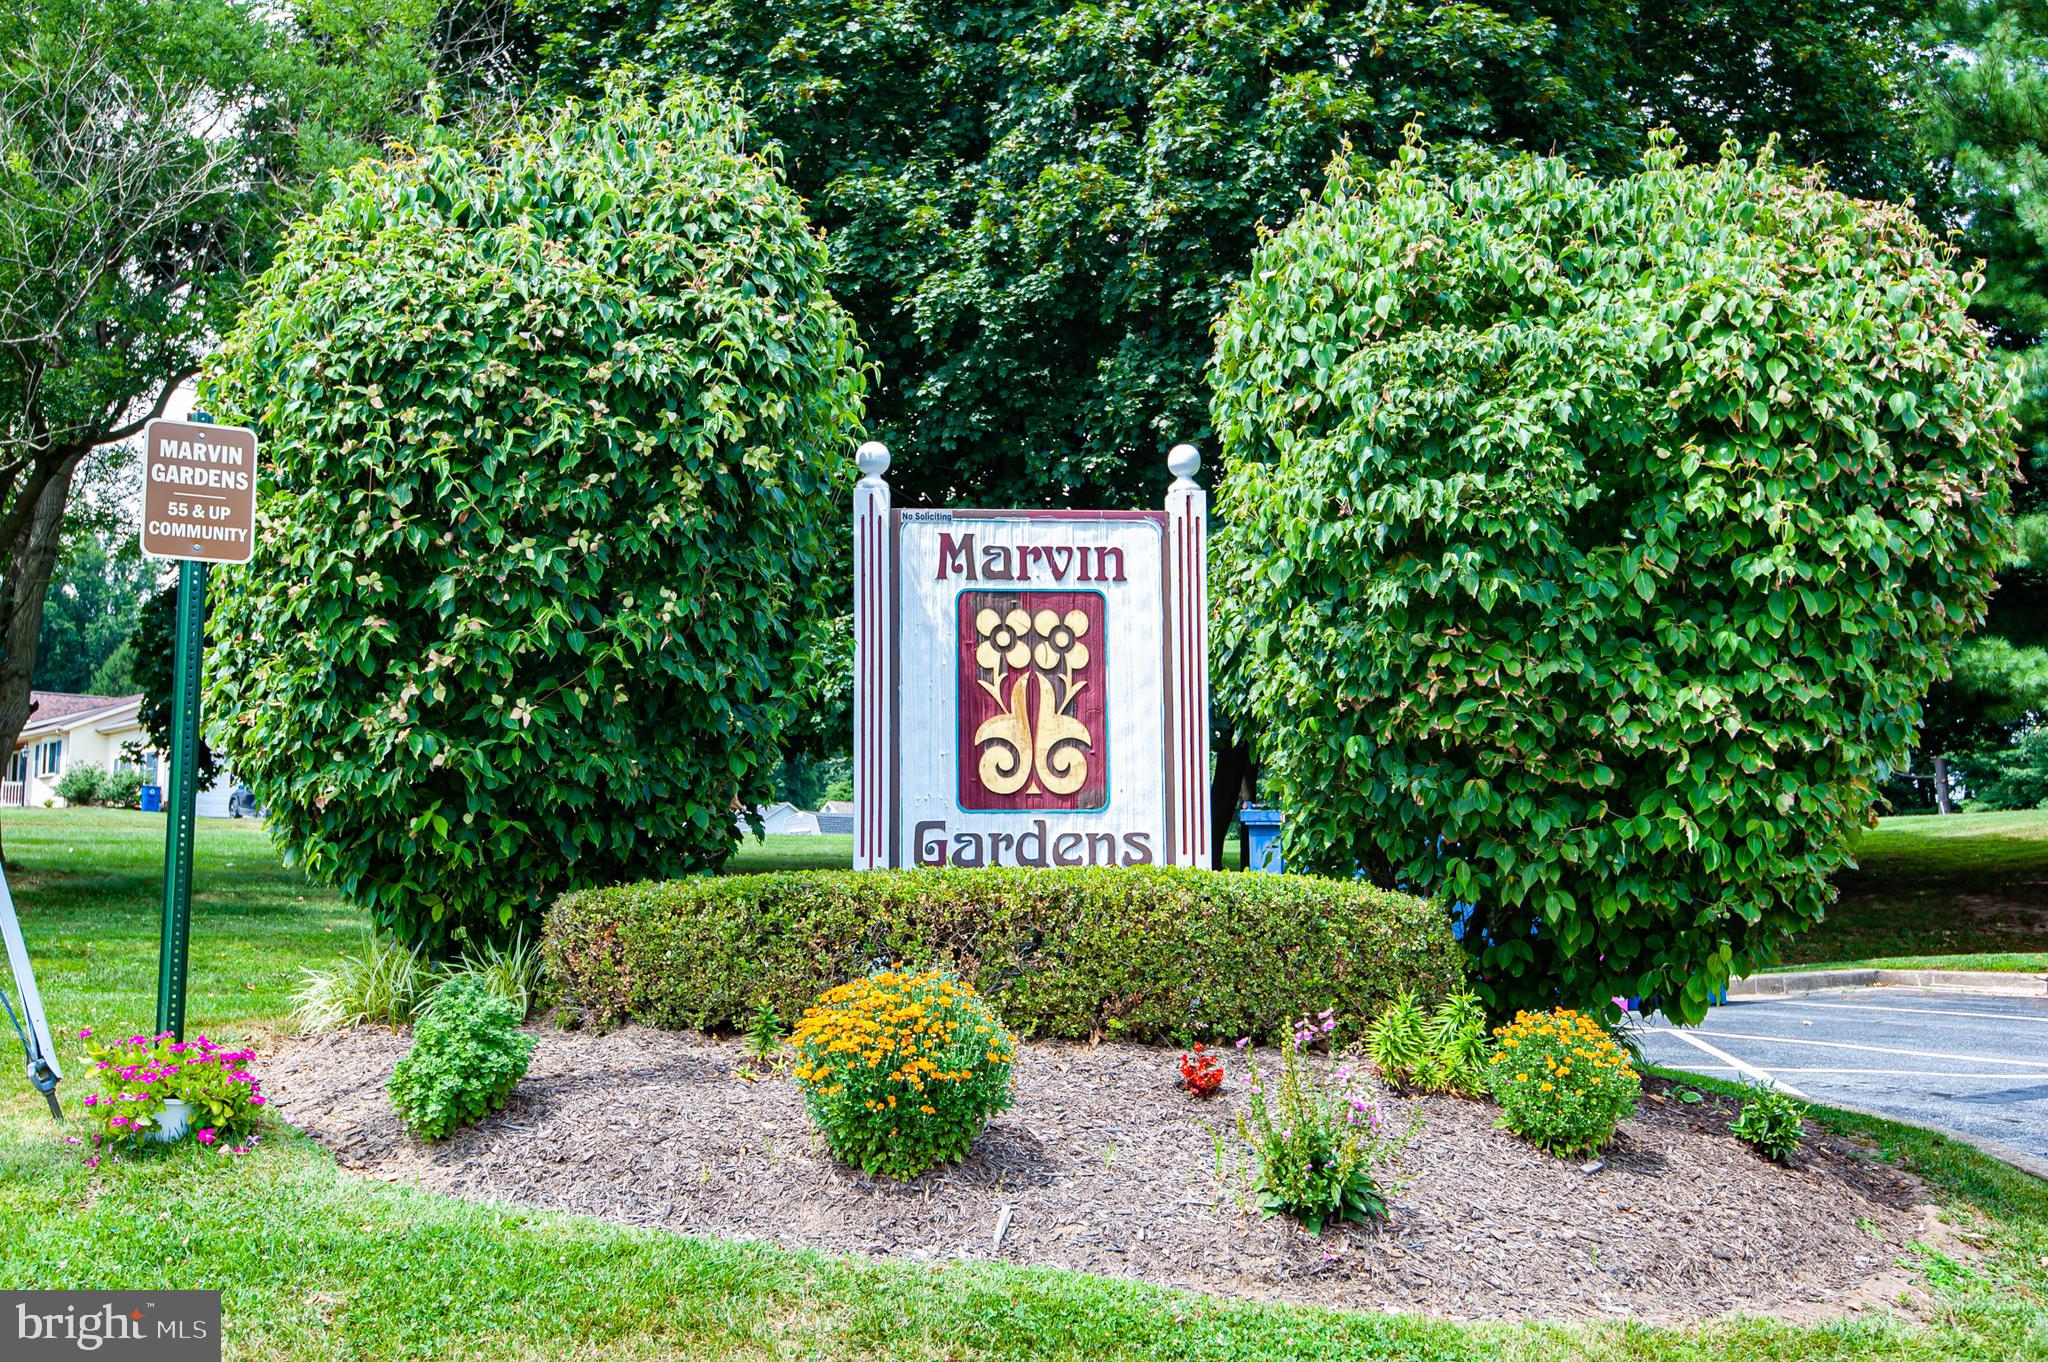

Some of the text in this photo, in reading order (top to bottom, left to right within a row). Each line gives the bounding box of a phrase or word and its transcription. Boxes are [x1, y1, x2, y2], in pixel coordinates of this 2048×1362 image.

[160, 439, 243, 465] MARVIN
[151, 463, 249, 491] GARDENS
[168, 502, 231, 520] 55 & UP
[902, 513, 952, 522] No Soliciting
[149, 521, 248, 542] COMMUNITY
[935, 532, 1127, 581] Marvin
[913, 820, 1153, 868] Gardens
